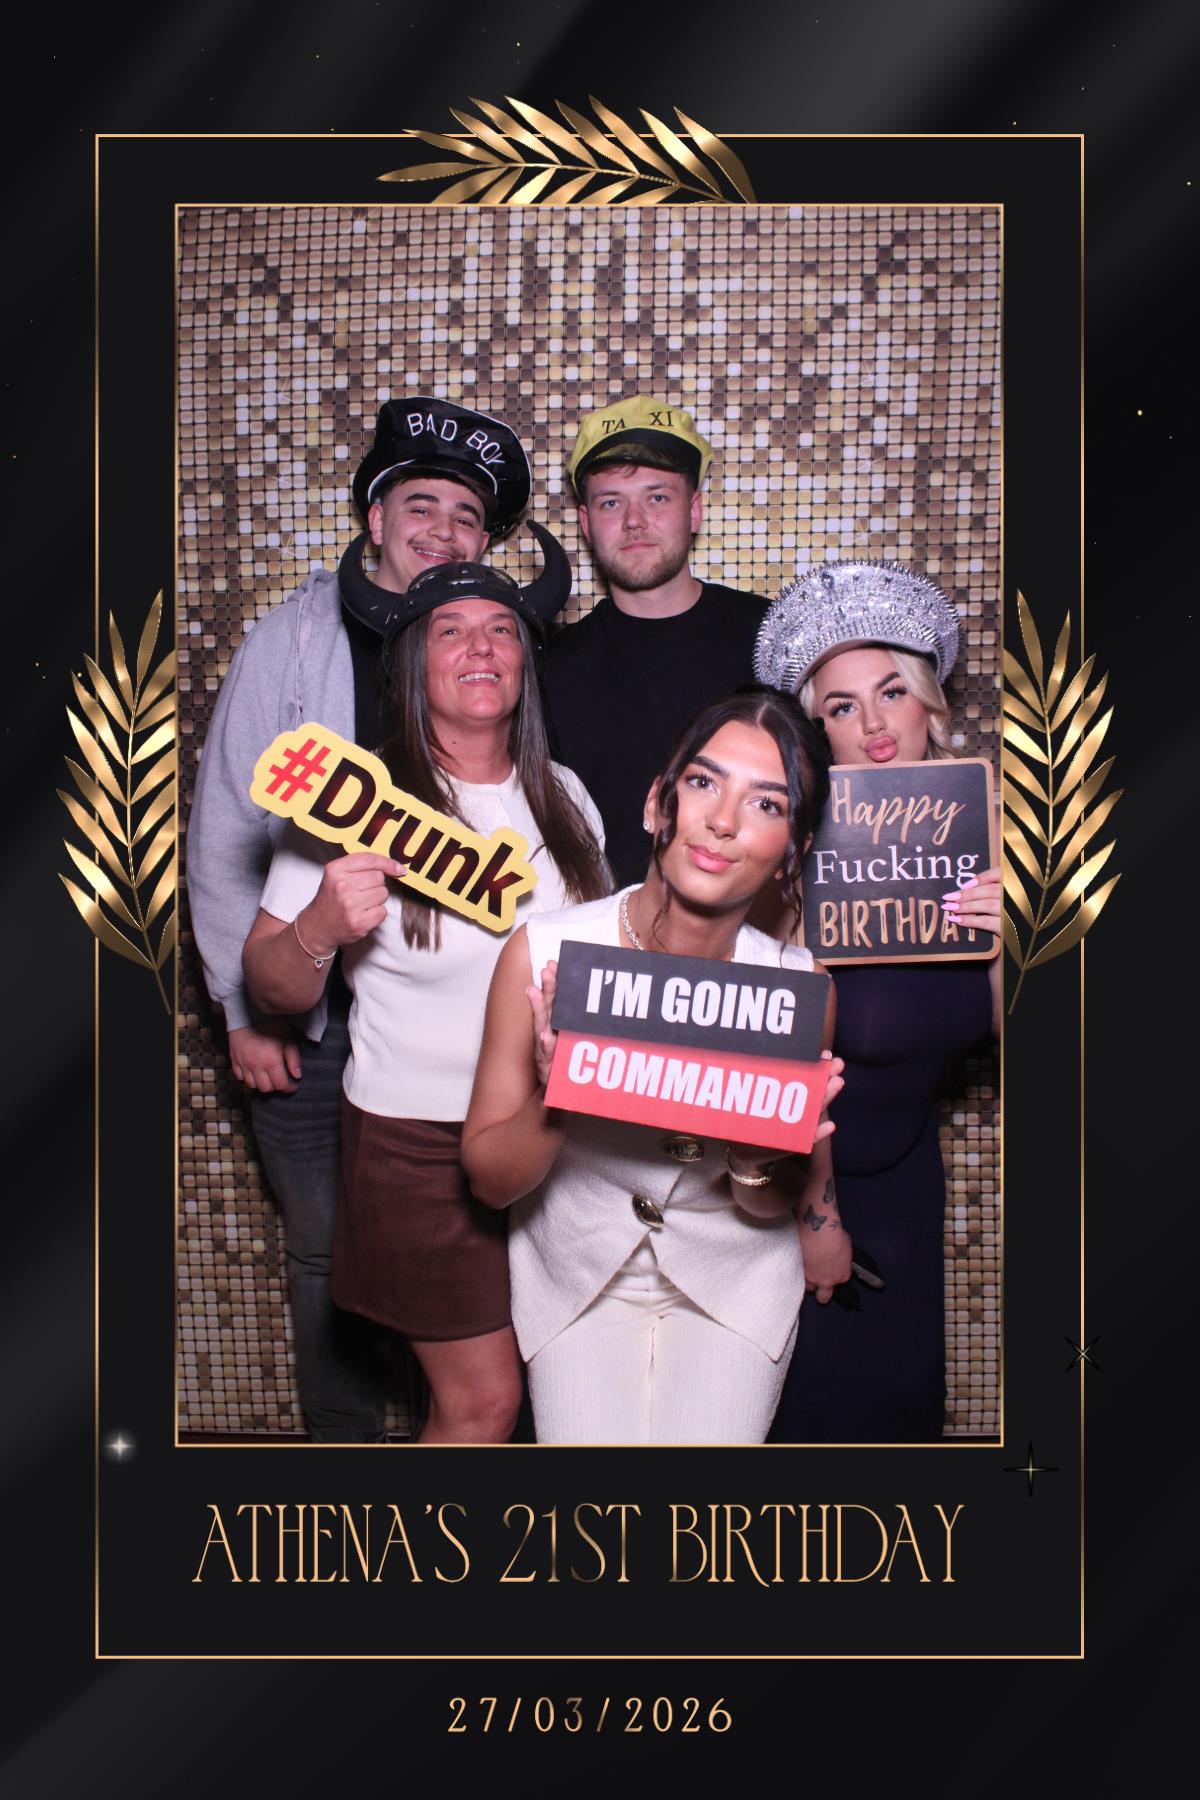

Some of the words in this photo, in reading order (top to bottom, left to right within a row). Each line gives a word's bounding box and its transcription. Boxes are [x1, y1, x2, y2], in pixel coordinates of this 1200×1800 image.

[406, 412, 458, 442] BAD
[265, 737, 525, 919] #Drunk
[831, 777, 966, 846] Happy
[813, 845, 980, 890] Fucking
[819, 896, 977, 949] BIRTHDA
[586, 968, 653, 1019] I’M
[660, 977, 796, 1035] GOING
[567, 1041, 808, 1124] COMMANDO
